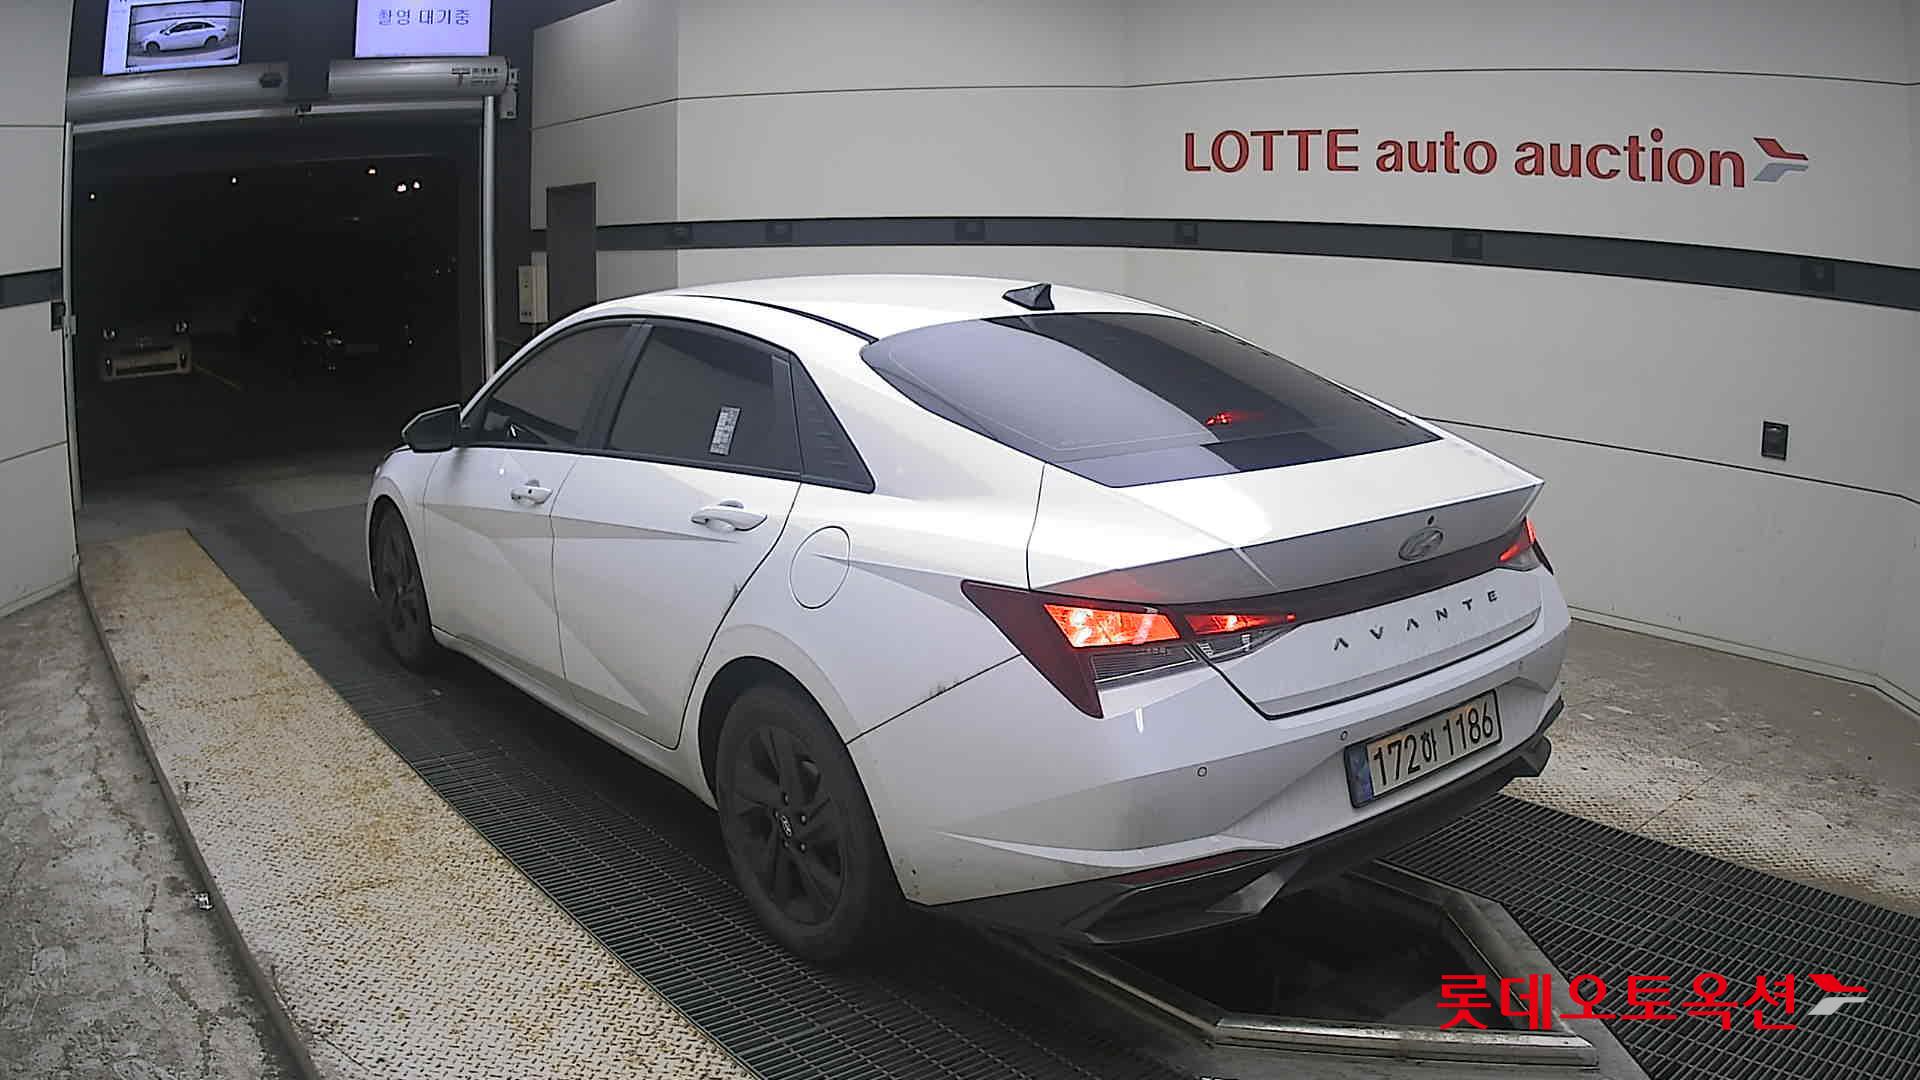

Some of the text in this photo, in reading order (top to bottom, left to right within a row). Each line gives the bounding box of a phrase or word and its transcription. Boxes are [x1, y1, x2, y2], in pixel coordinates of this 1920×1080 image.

[419, 8, 470, 26] 대기중
[1185, 128, 1746, 188] LOTTE auto auction
[1333, 590, 1498, 651] AVANTE
[1373, 702, 1494, 786] 172하 1186
